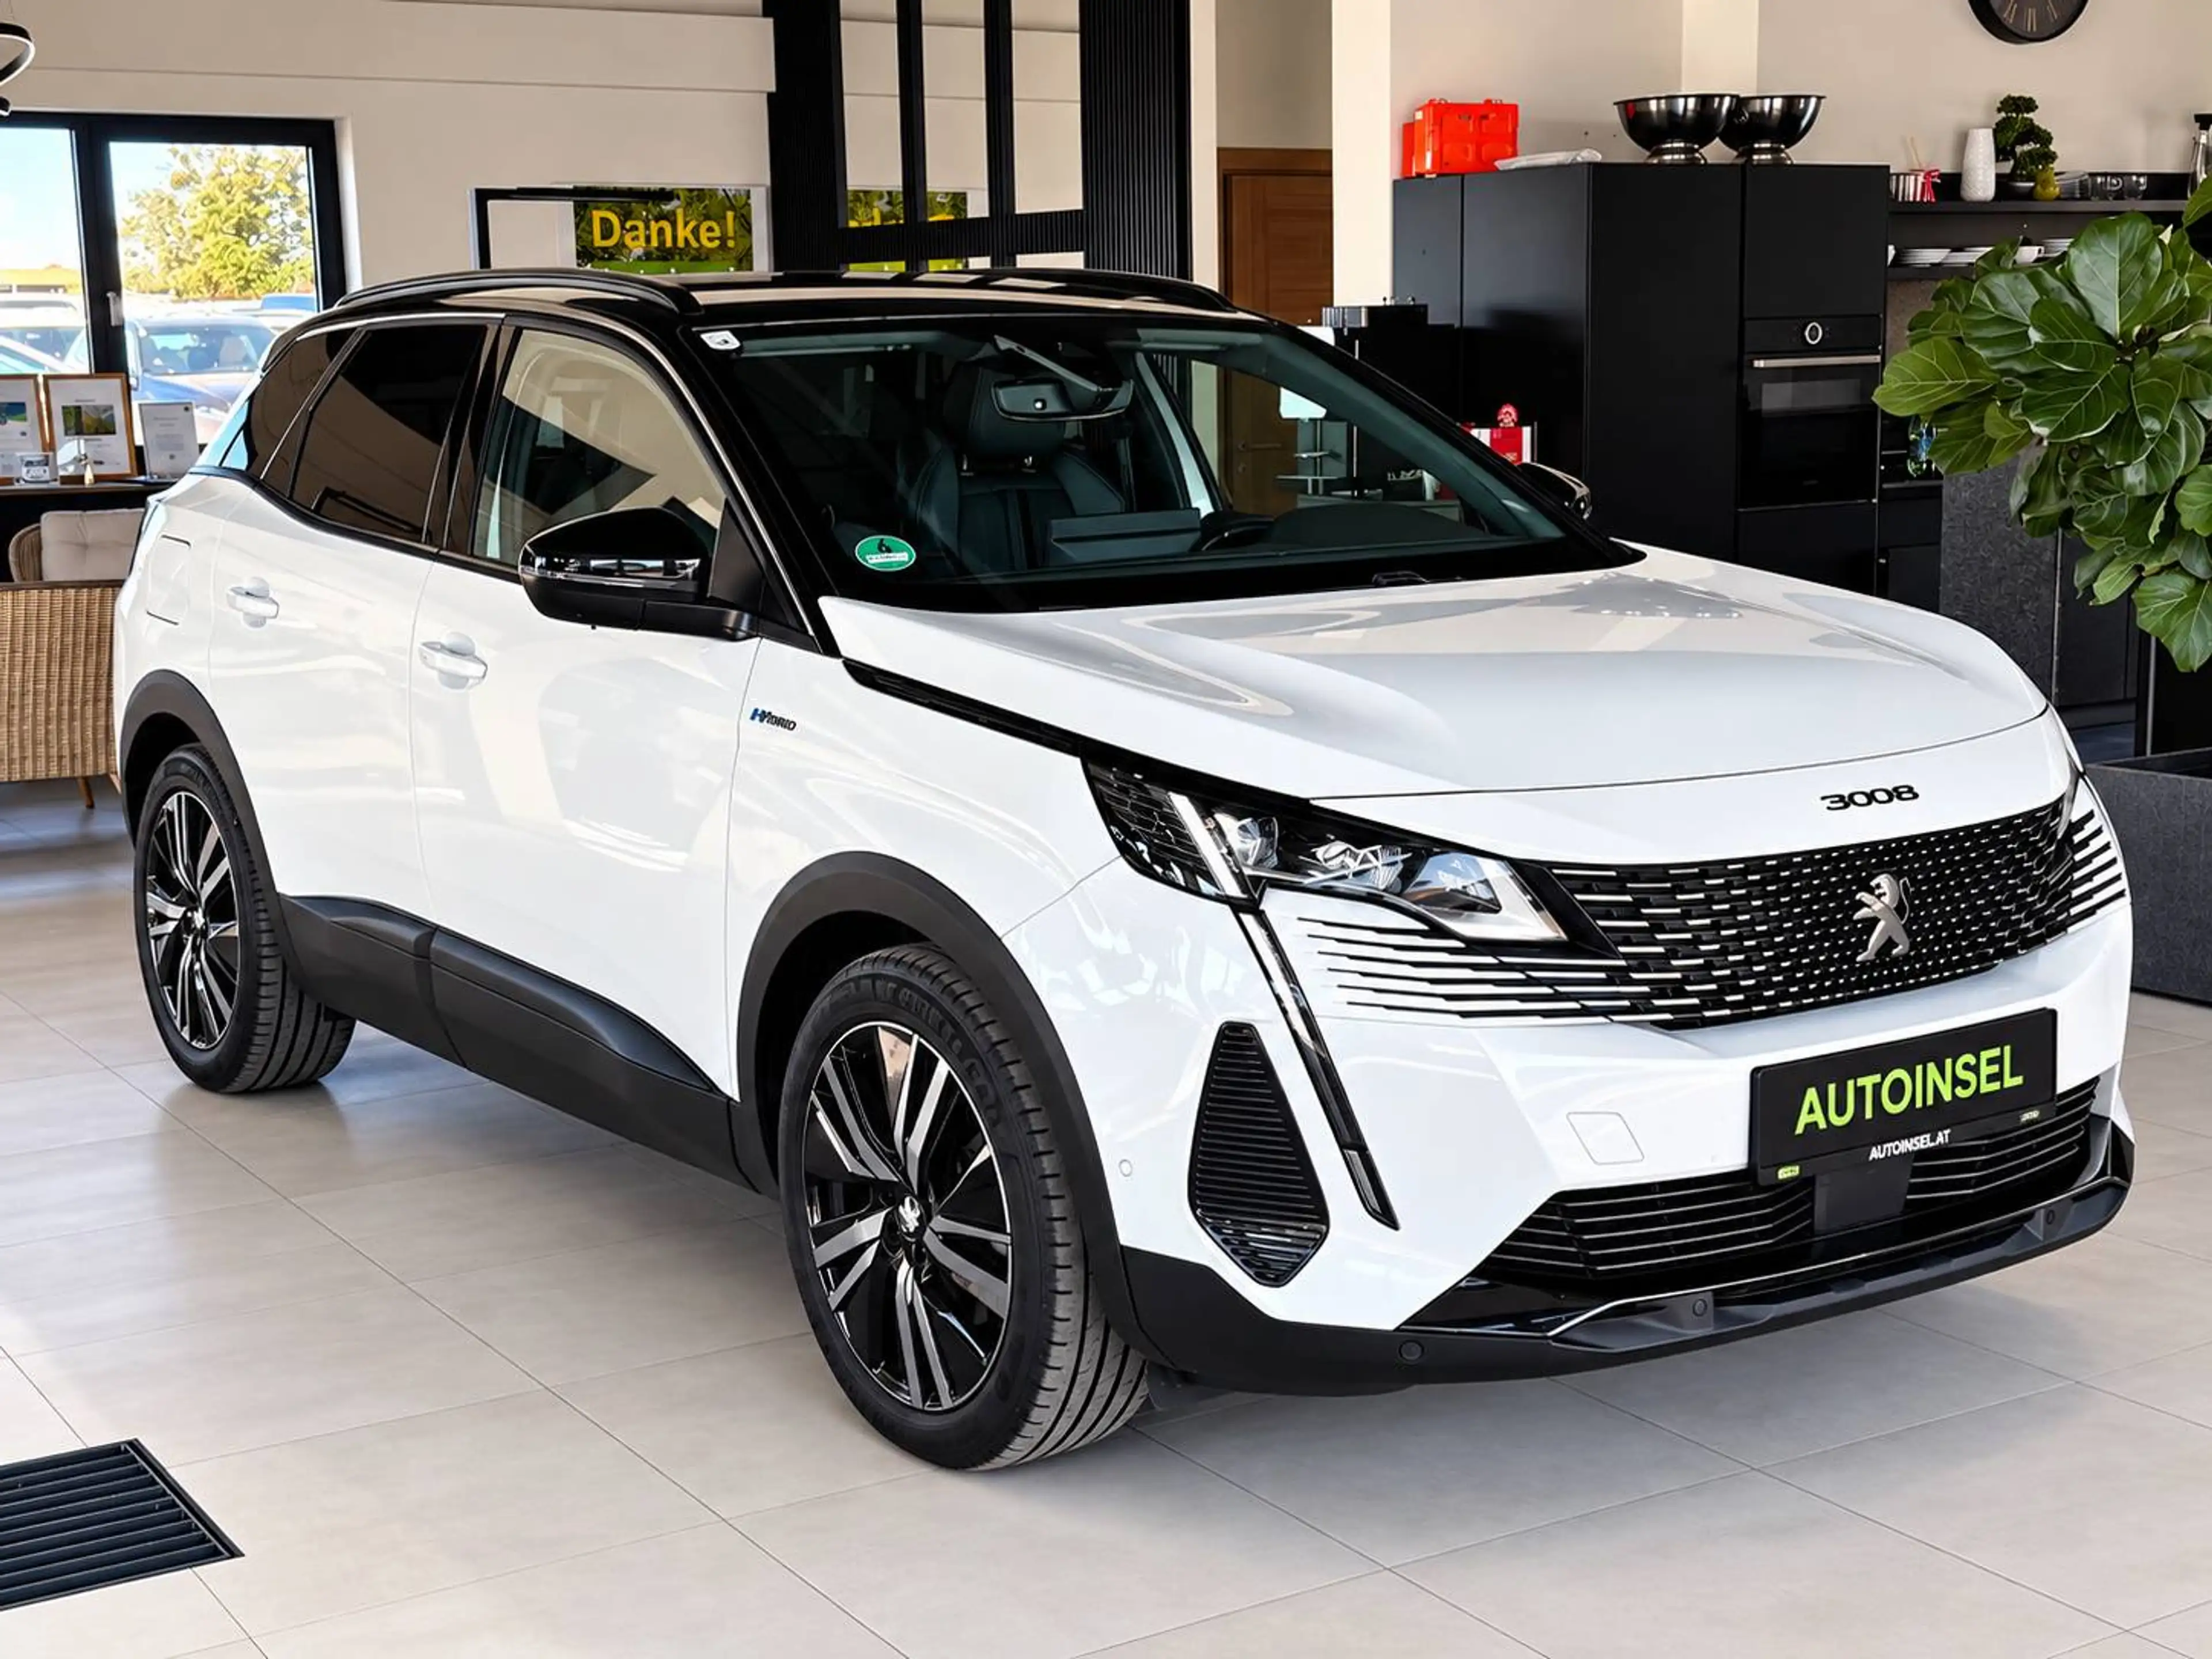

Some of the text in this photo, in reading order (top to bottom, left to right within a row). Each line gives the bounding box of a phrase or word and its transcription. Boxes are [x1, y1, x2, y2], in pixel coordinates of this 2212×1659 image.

[592, 208, 735, 248] Danke!
[1820, 785, 1919, 810] 3008
[1794, 1044, 2024, 1135] AUTOINSEL
[1868, 1128, 1952, 1161] AUTOINSEL.AT
